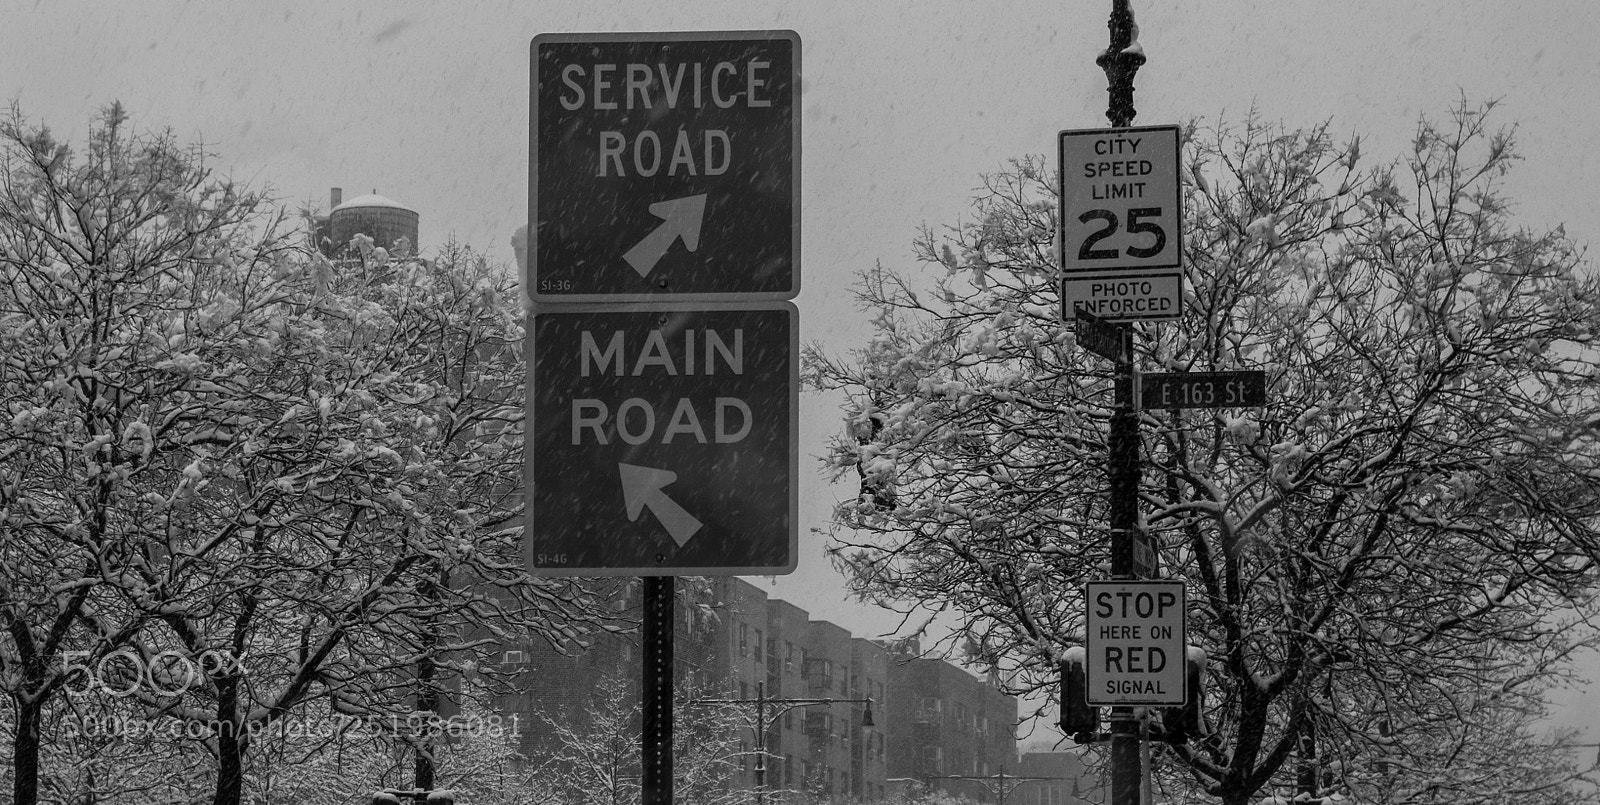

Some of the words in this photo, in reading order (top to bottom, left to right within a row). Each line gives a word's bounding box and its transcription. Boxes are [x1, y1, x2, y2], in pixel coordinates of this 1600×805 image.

[559, 61, 772, 111] SERVICE
[597, 129, 732, 178] ROAD
[1094, 138, 1142, 155] CITY
[1083, 160, 1153, 178] SPEED
[1092, 182, 1146, 200] LIMIT
[1077, 207, 1167, 260] 25
[1091, 281, 1152, 297] PHOTO
[580, 328, 744, 378] MAIN
[1162, 383, 1171, 405] E
[1181, 382, 1215, 405] 163
[1225, 381, 1246, 404] St
[571, 397, 753, 446] ROAD
[1095, 592, 1176, 619] STOP
[1100, 626, 1142, 639] HERE
[1151, 626, 1172, 639] ON
[1105, 647, 1167, 674] RED
[1106, 680, 1166, 695] SIGNAL
